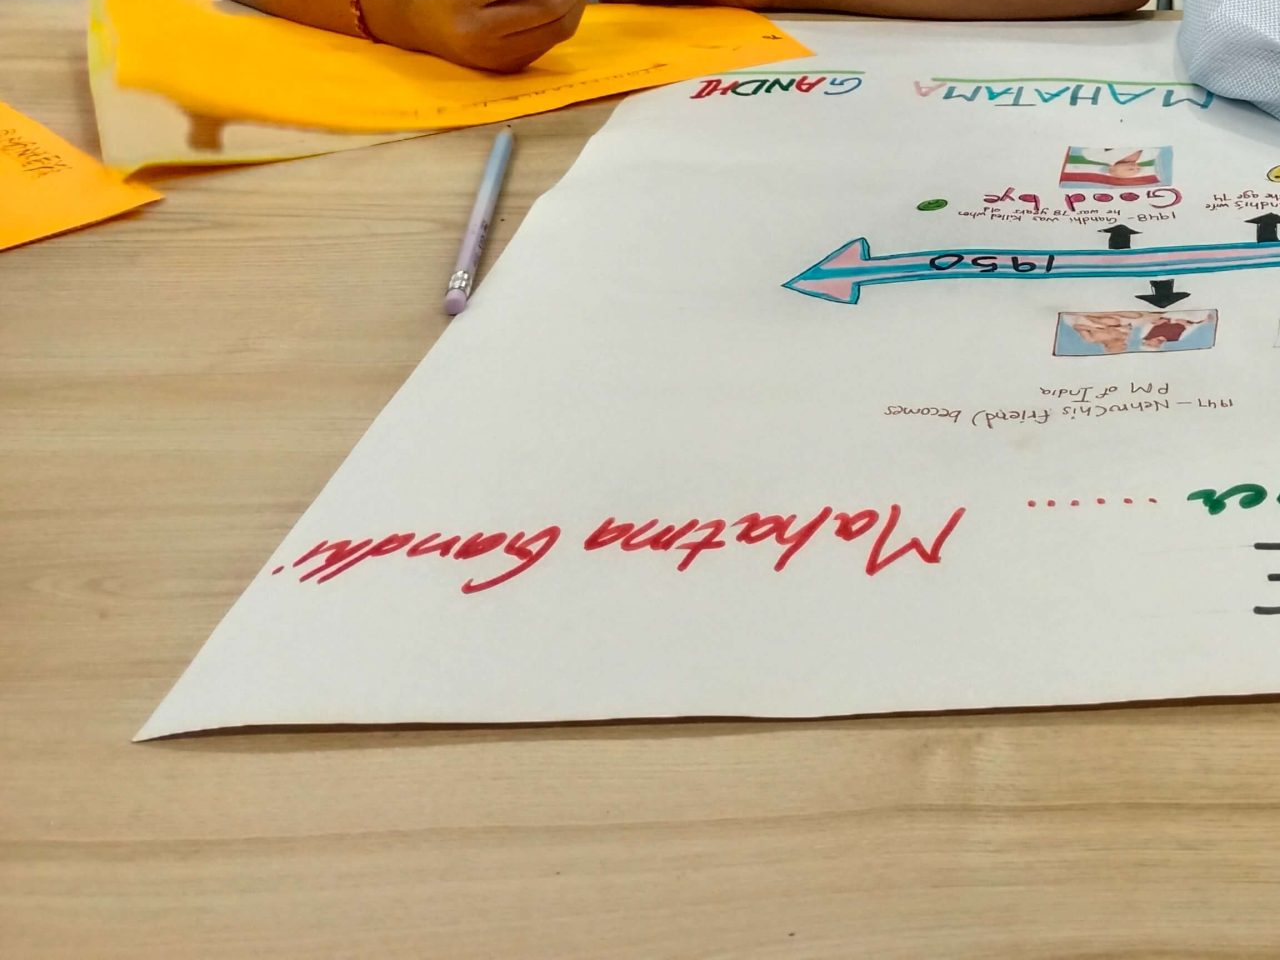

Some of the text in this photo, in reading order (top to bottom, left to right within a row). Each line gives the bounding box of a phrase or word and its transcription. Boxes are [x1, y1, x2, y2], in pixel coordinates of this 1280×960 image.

[689, 76, 862, 100] GANDHI
[983, 187, 1183, 212] Good bye
[1236, 190, 1259, 200] age
[929, 254, 1055, 274] 1950
[1040, 386, 1092, 404] India
[1095, 385, 1118, 399] of
[884, 405, 961, 423] becomes
[583, 504, 966, 577] Mahatma
[270, 525, 562, 595] Gandhi
